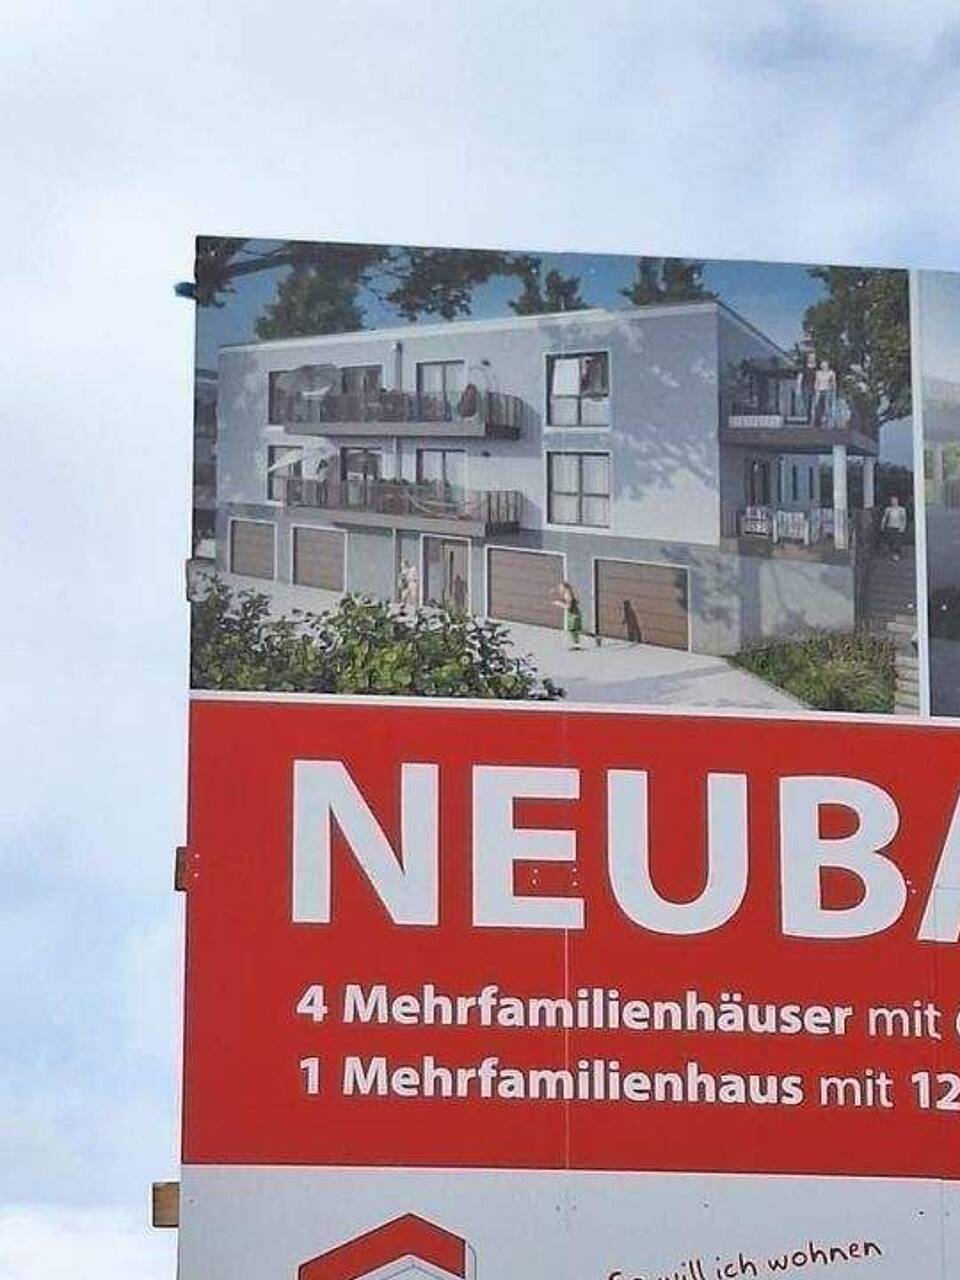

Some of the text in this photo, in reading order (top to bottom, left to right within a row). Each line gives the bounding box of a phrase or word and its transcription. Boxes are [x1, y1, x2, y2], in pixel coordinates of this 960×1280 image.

[297, 984, 327, 1022] 4
[343, 983, 852, 1036] Mehrfamilienhäuser
[867, 1000, 941, 1038] mit
[300, 1057, 320, 1094] 1
[343, 1056, 803, 1106] Mehrfamilienhaus
[819, 1070, 893, 1109] mit
[714, 1253, 757, 1280] ich
[766, 1240, 883, 1274] wohnen
